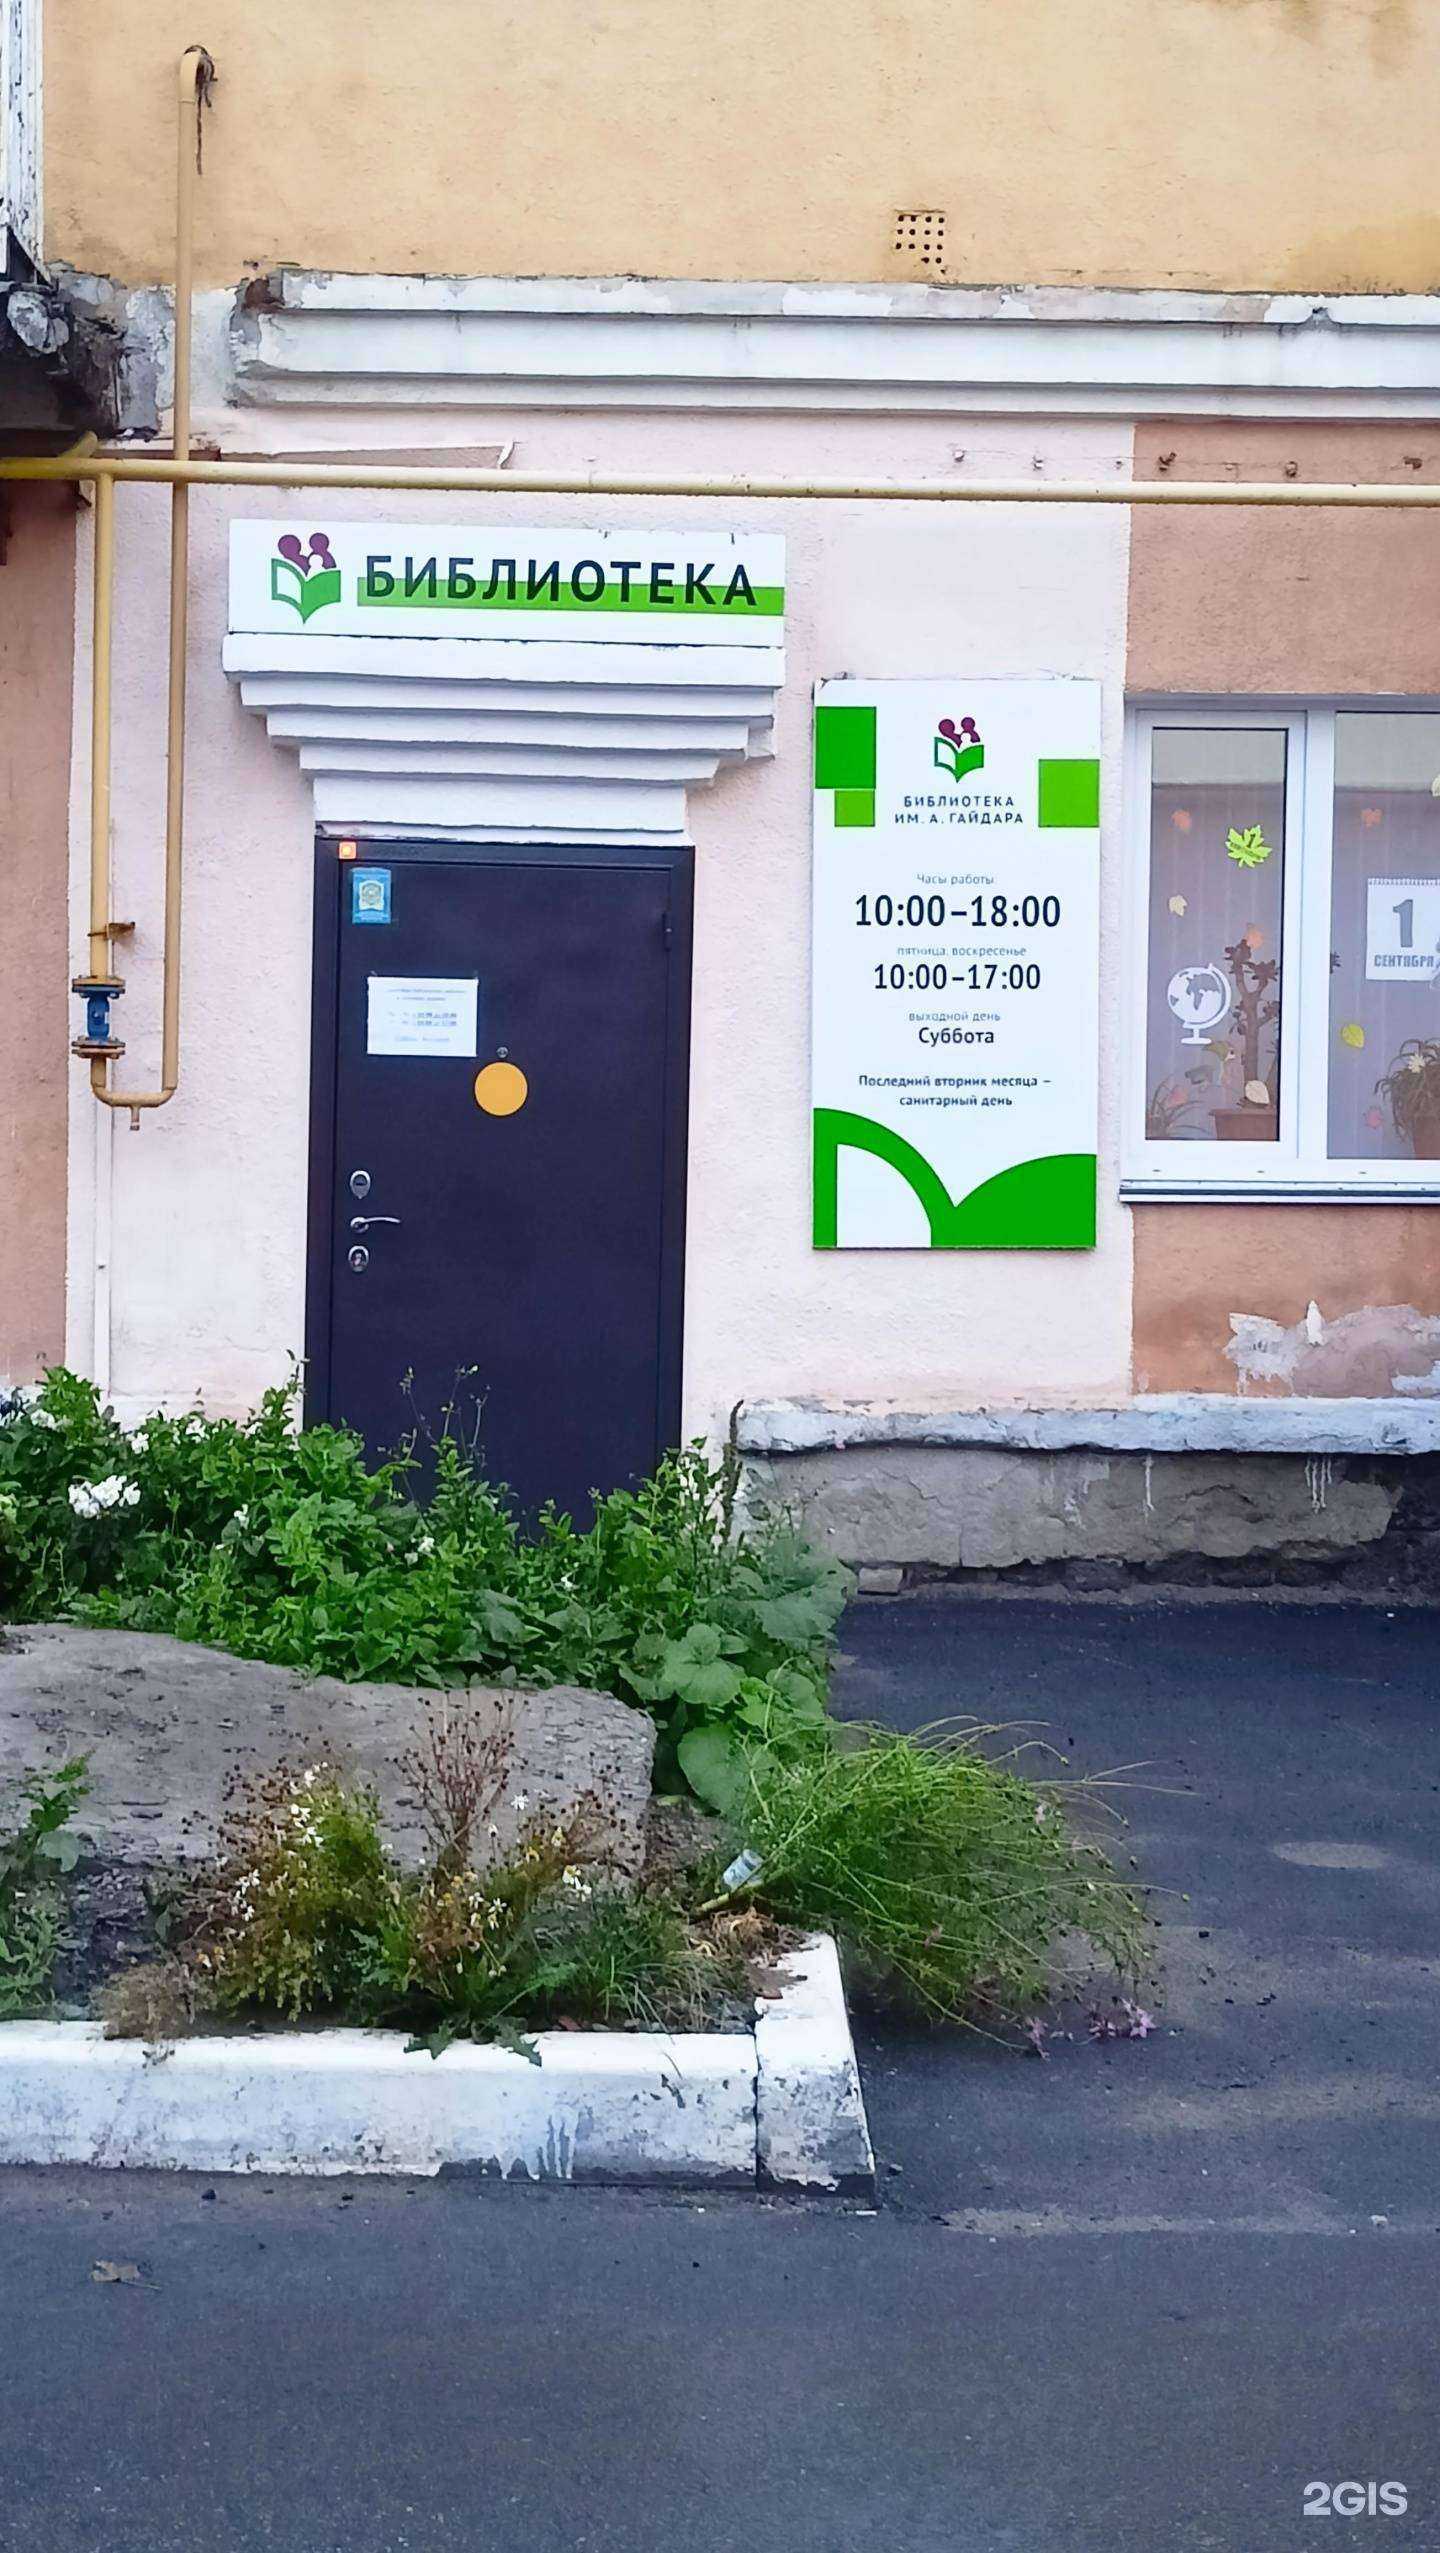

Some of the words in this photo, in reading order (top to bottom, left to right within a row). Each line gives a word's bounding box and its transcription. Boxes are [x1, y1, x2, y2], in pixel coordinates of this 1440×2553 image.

[367, 556, 756, 605] БИБЛИОТЕКА
[904, 796, 1014, 807] БИБЛИОТЕКА
[895, 814, 924, 824] ИМ.
[929, 814, 944, 824] А.
[950, 811, 1023, 825] ГАЙДАРА
[917, 874, 946, 884] Часы
[951, 874, 994, 885] работы
[1393, 899, 1413, 947] 1
[952, 948, 1026, 957] воскресенье
[909, 1012, 968, 1022] выходной
[973, 1013, 1000, 1022] день
[919, 1027, 994, 1047] Суббота
[859, 1075, 930, 1088] Последний
[935, 1078, 987, 1088] вторник
[992, 1078, 1037, 1087] месяца
[900, 1095, 977, 1108] санитарный
[981, 1097, 1012, 1107] день
